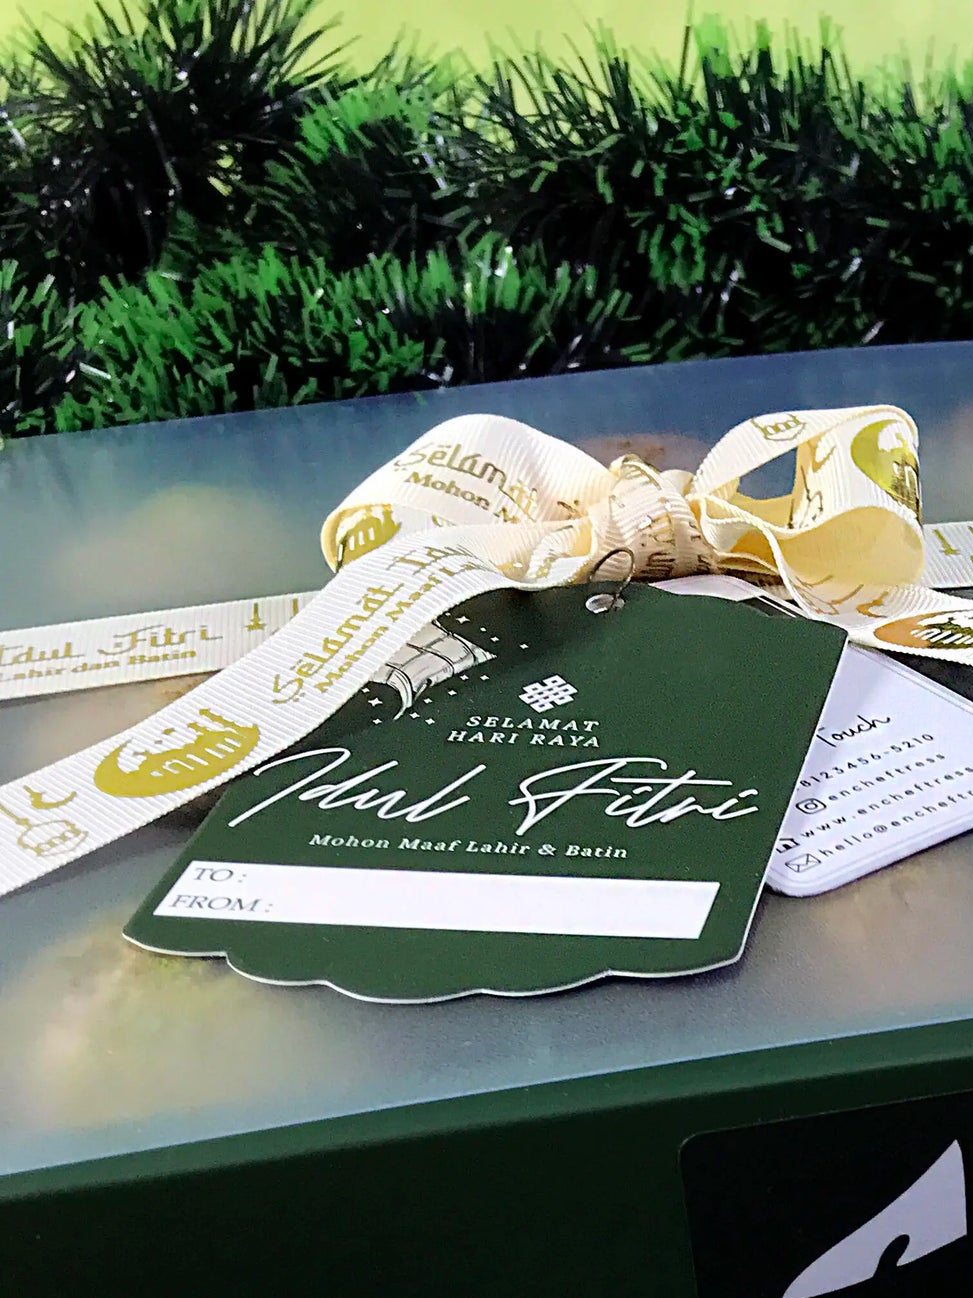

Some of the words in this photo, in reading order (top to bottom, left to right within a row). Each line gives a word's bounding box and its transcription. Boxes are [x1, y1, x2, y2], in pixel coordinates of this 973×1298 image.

[404, 471, 490, 511] Mohon
[97, 624, 223, 656] Fitri
[272, 583, 404, 704] Selamat
[71, 661, 120, 673] dan
[128, 650, 196, 665] Batin
[314, 626, 389, 693] Mohon
[447, 730, 518, 745] HARI
[529, 733, 600, 748] RAYA
[466, 716, 600, 732] SELAMAT
[228, 747, 487, 828] Idul
[508, 757, 760, 836] Fitri
[827, 753, 946, 802] encheftress
[308, 834, 390, 850] Mohon
[398, 838, 462, 851] Maaf
[466, 840, 531, 856] Lahir
[537, 844, 556, 857] &
[565, 844, 628, 859] Batin
